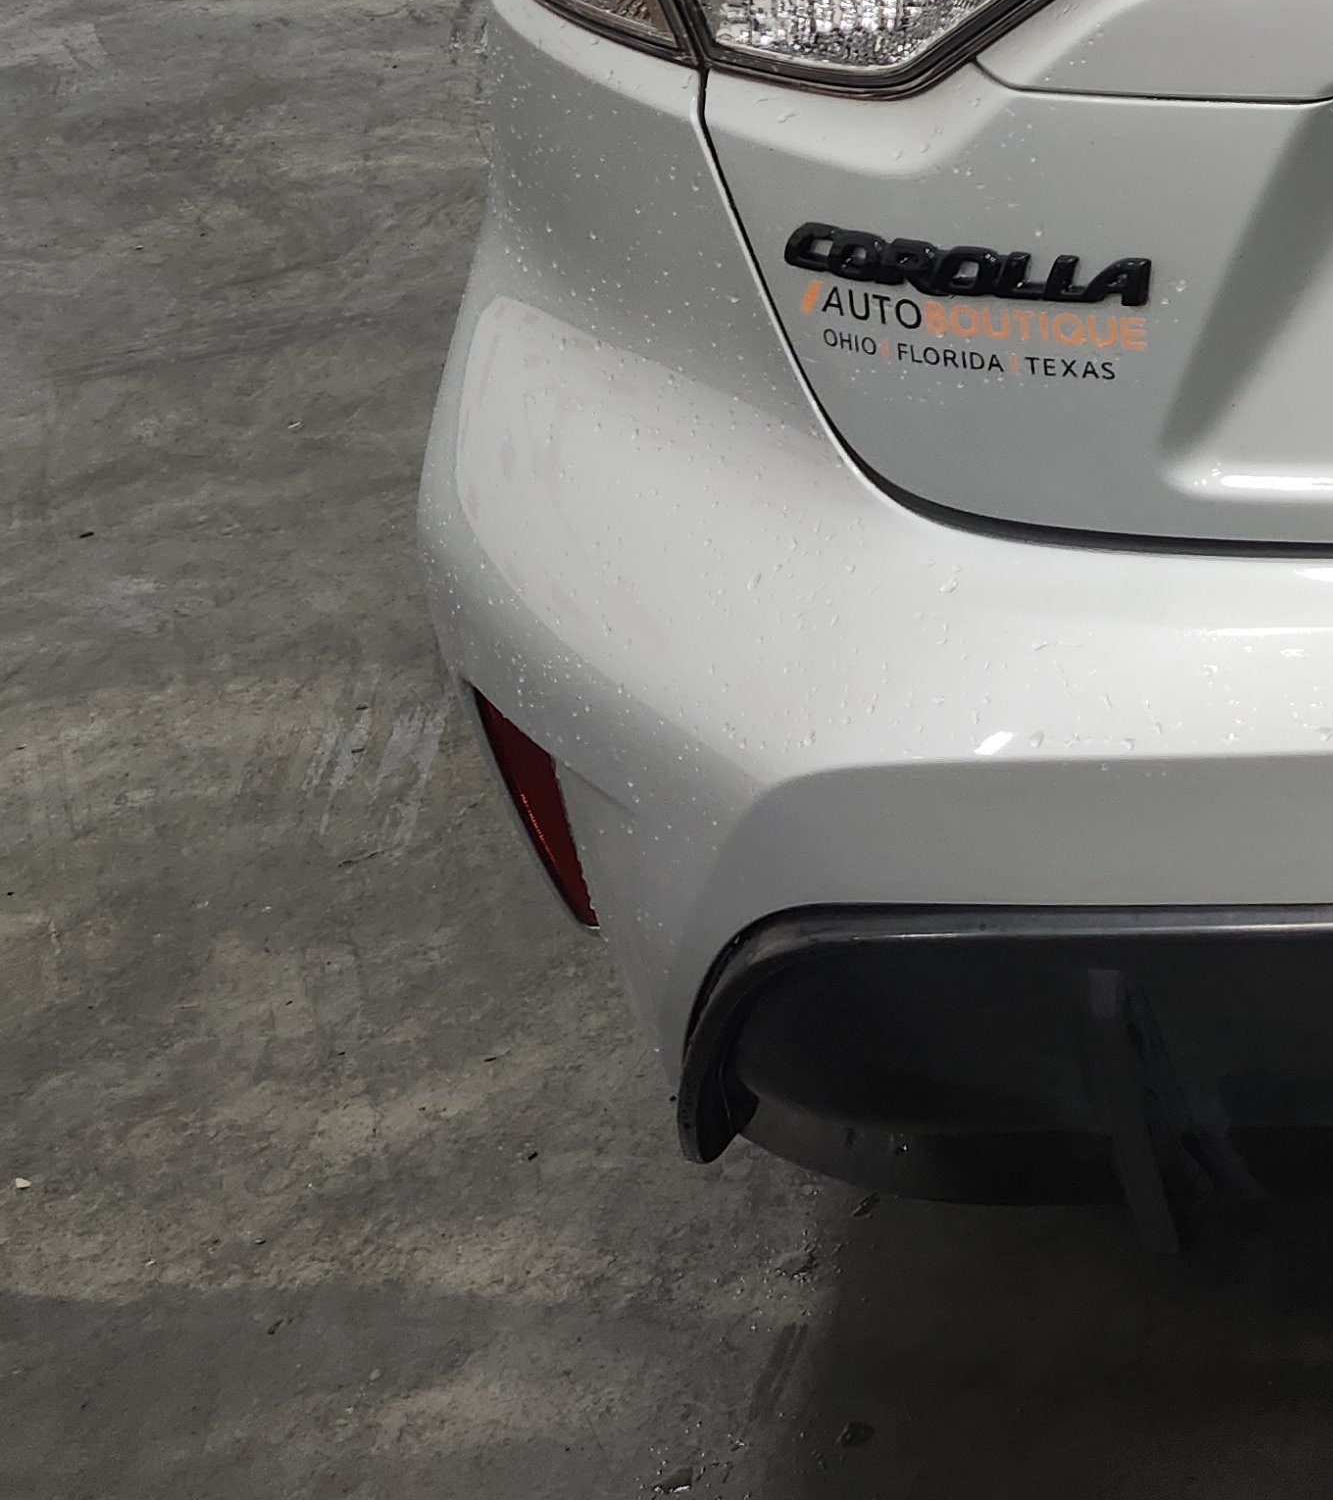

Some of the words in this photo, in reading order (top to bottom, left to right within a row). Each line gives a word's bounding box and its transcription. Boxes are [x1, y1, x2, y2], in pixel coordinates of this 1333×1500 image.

[784, 221, 1152, 307] COROLLA
[821, 285, 1148, 350] AUTOBOUTIQUE
[822, 328, 878, 356] OHIO
[896, 342, 1005, 373] FLORIDA
[1024, 356, 1117, 381] TEXAS
